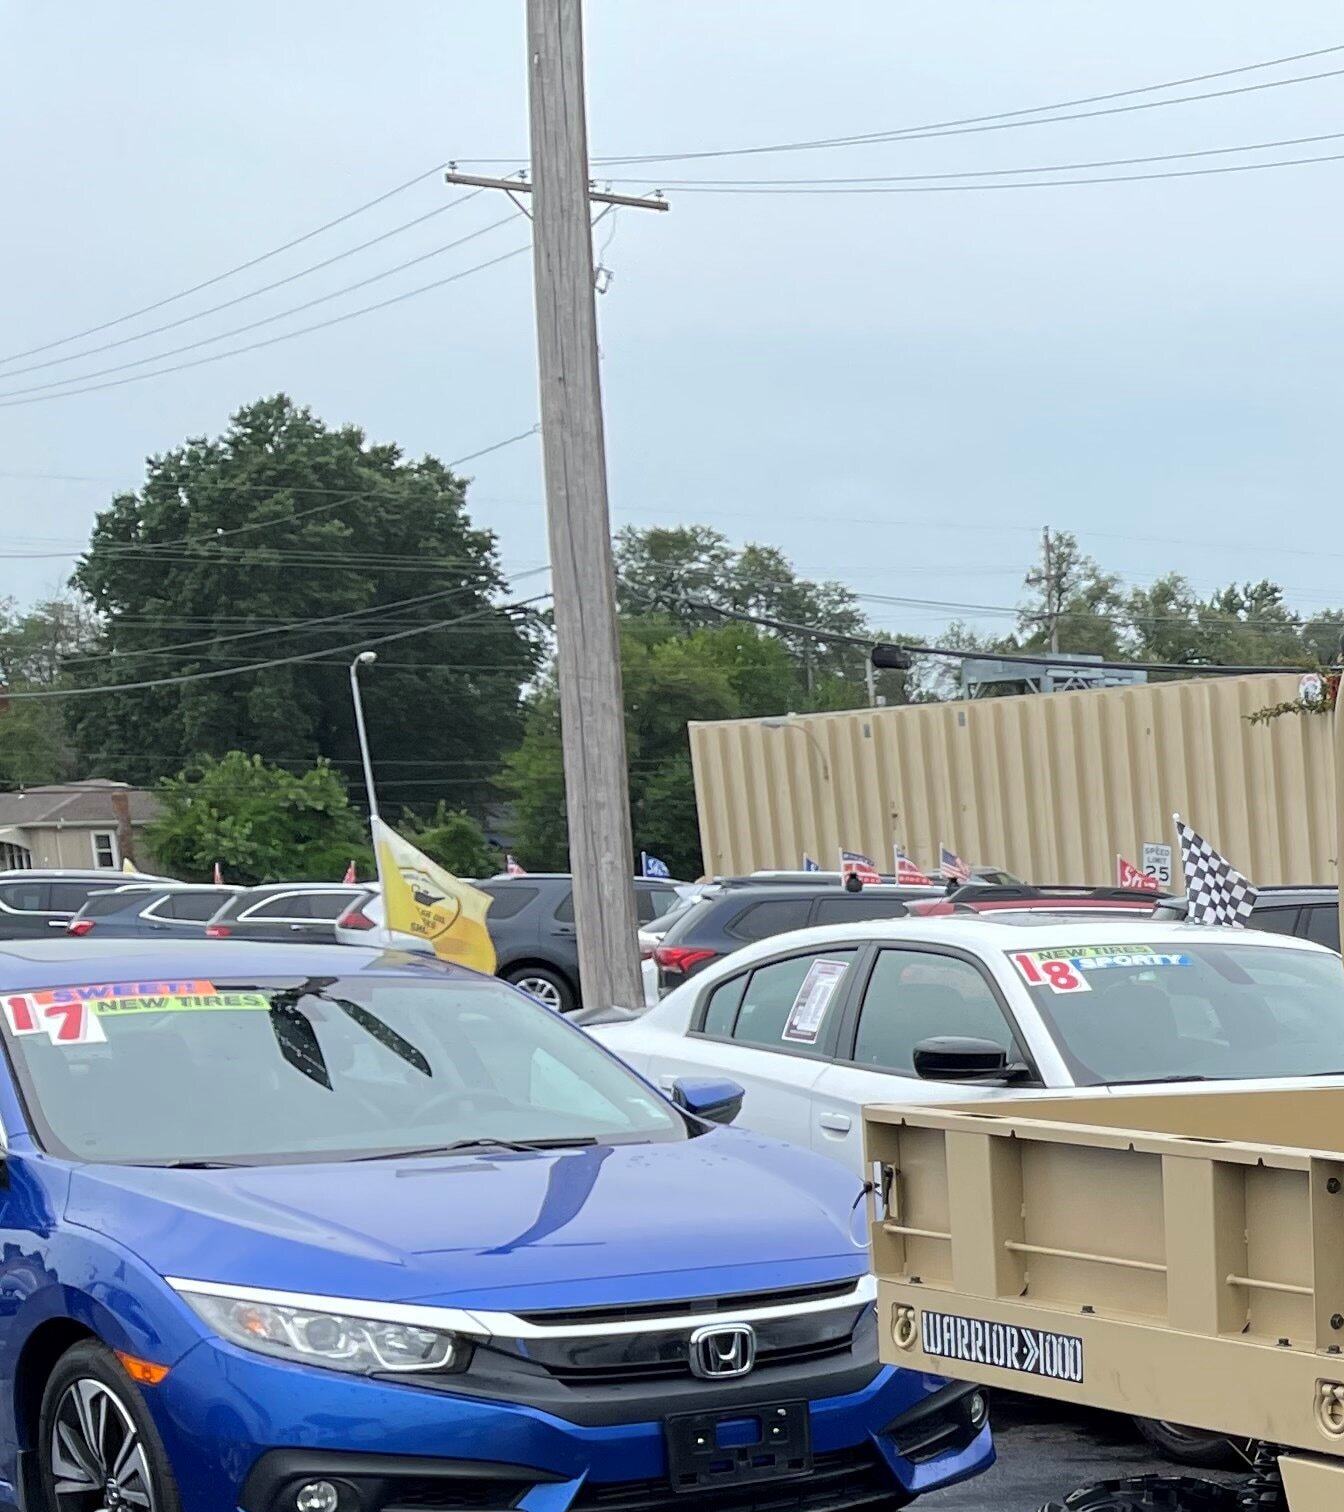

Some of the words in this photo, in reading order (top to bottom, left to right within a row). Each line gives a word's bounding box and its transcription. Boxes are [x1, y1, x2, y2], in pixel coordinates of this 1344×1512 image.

[1145, 847, 1169, 856] SPEED
[1146, 866, 1169, 881] 25
[1039, 948, 1082, 959] NEW
[1093, 945, 1148, 954] TIRES
[1079, 954, 1182, 969] SPORTY
[1016, 955, 1078, 989] 18
[53, 984, 195, 1001] SWEET!
[97, 997, 165, 1012] NEW
[175, 995, 260, 1007] TIRES
[8, 998, 82, 1040] 17
[922, 1312, 1020, 1369] WARRIOR
